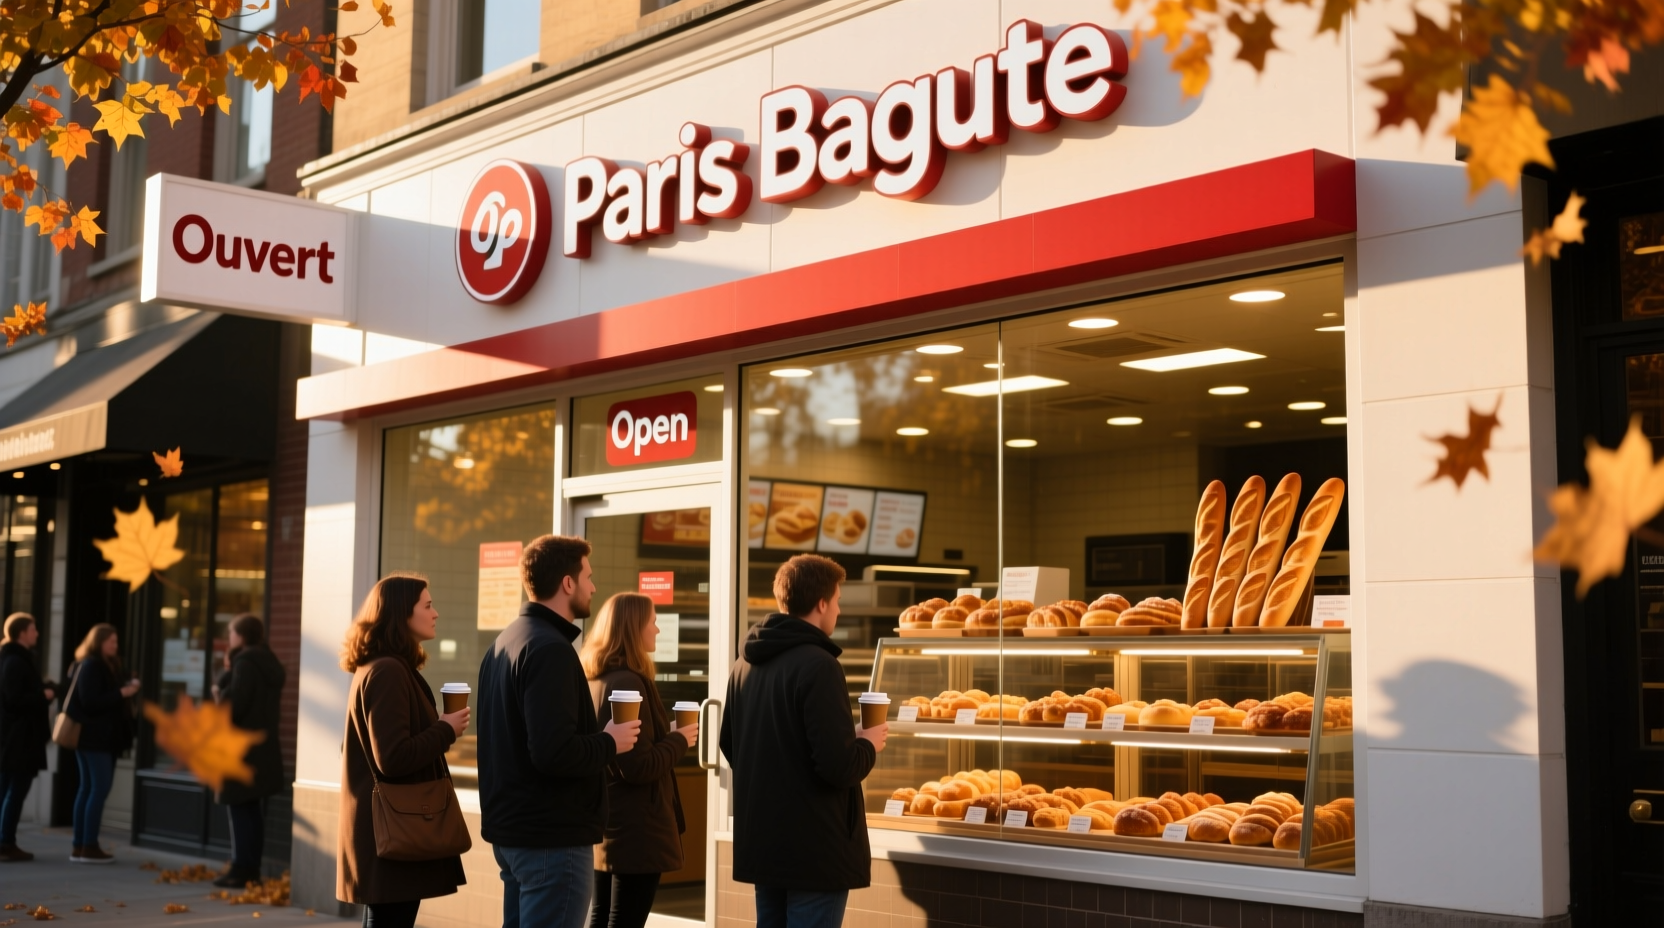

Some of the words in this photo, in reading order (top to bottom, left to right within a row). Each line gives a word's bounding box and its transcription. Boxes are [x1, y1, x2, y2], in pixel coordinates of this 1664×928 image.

[563, 121, 746, 258] Paris
[760, 19, 1122, 200] Bagute
[172, 214, 335, 284] Ouvert
[611, 409, 689, 457] Open
